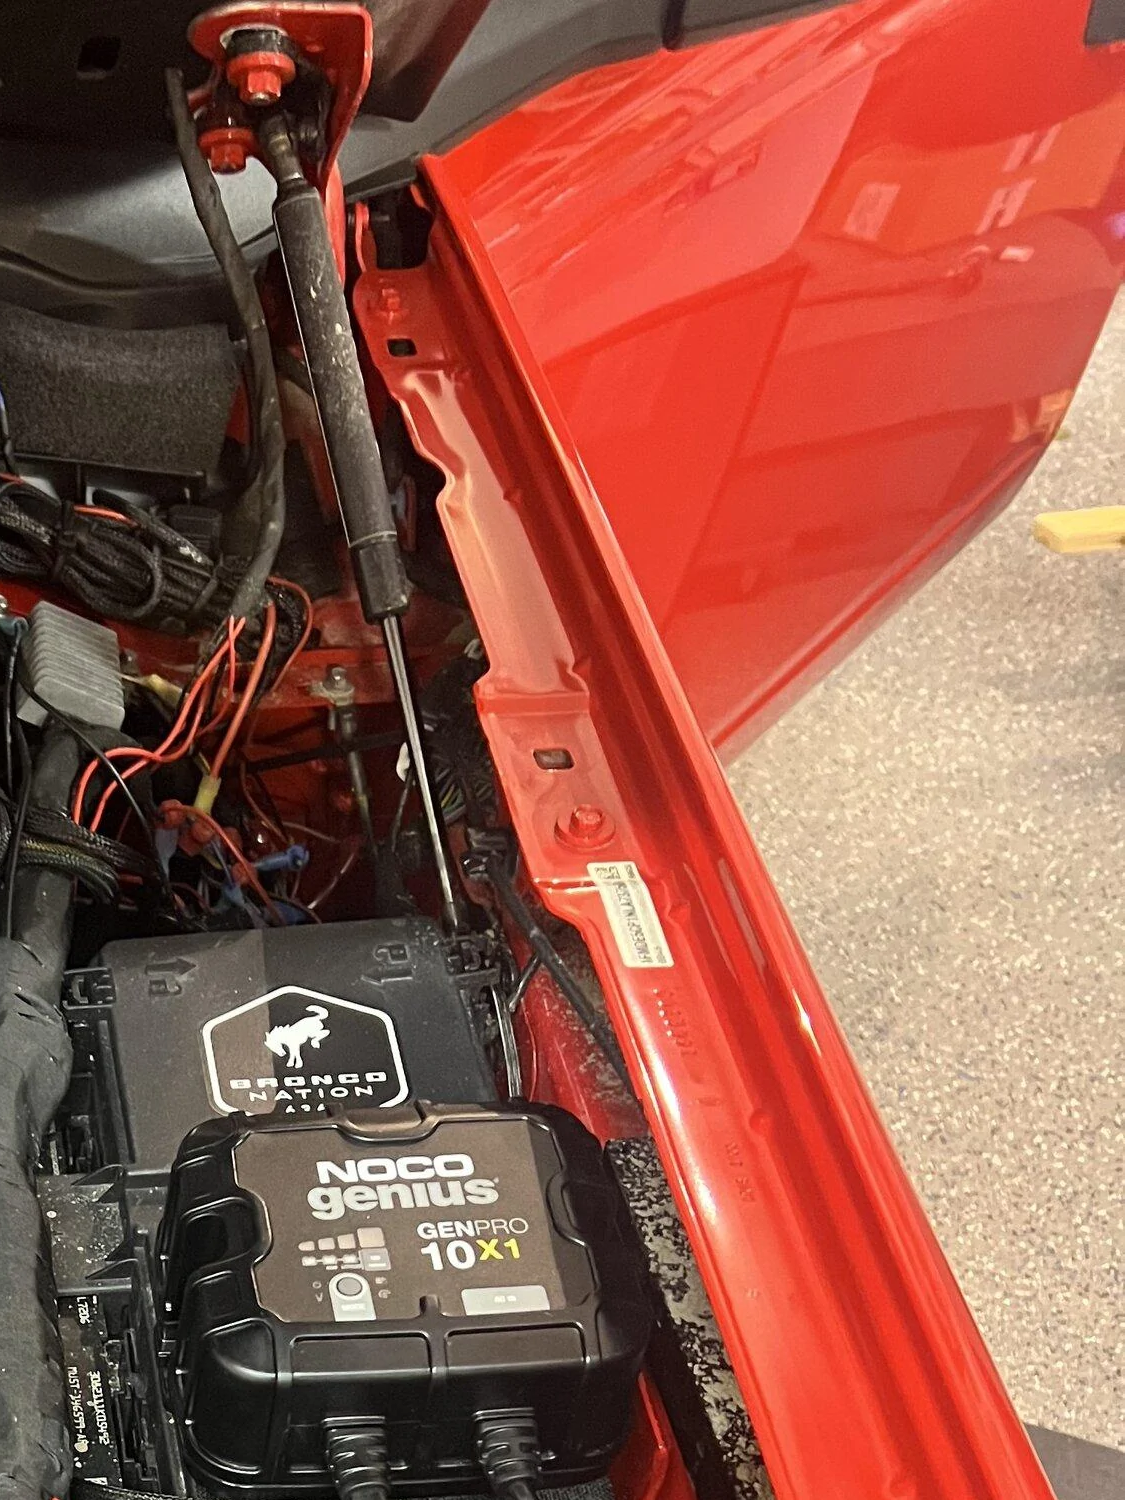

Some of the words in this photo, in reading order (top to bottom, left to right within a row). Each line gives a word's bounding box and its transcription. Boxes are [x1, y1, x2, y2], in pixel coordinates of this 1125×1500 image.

[229, 1071, 388, 1090] BRONCO
[249, 1085, 374, 1103] NATION
[315, 1153, 475, 1185] NOCO
[307, 1178, 499, 1221] genius
[416, 1217, 530, 1240] GENPRO
